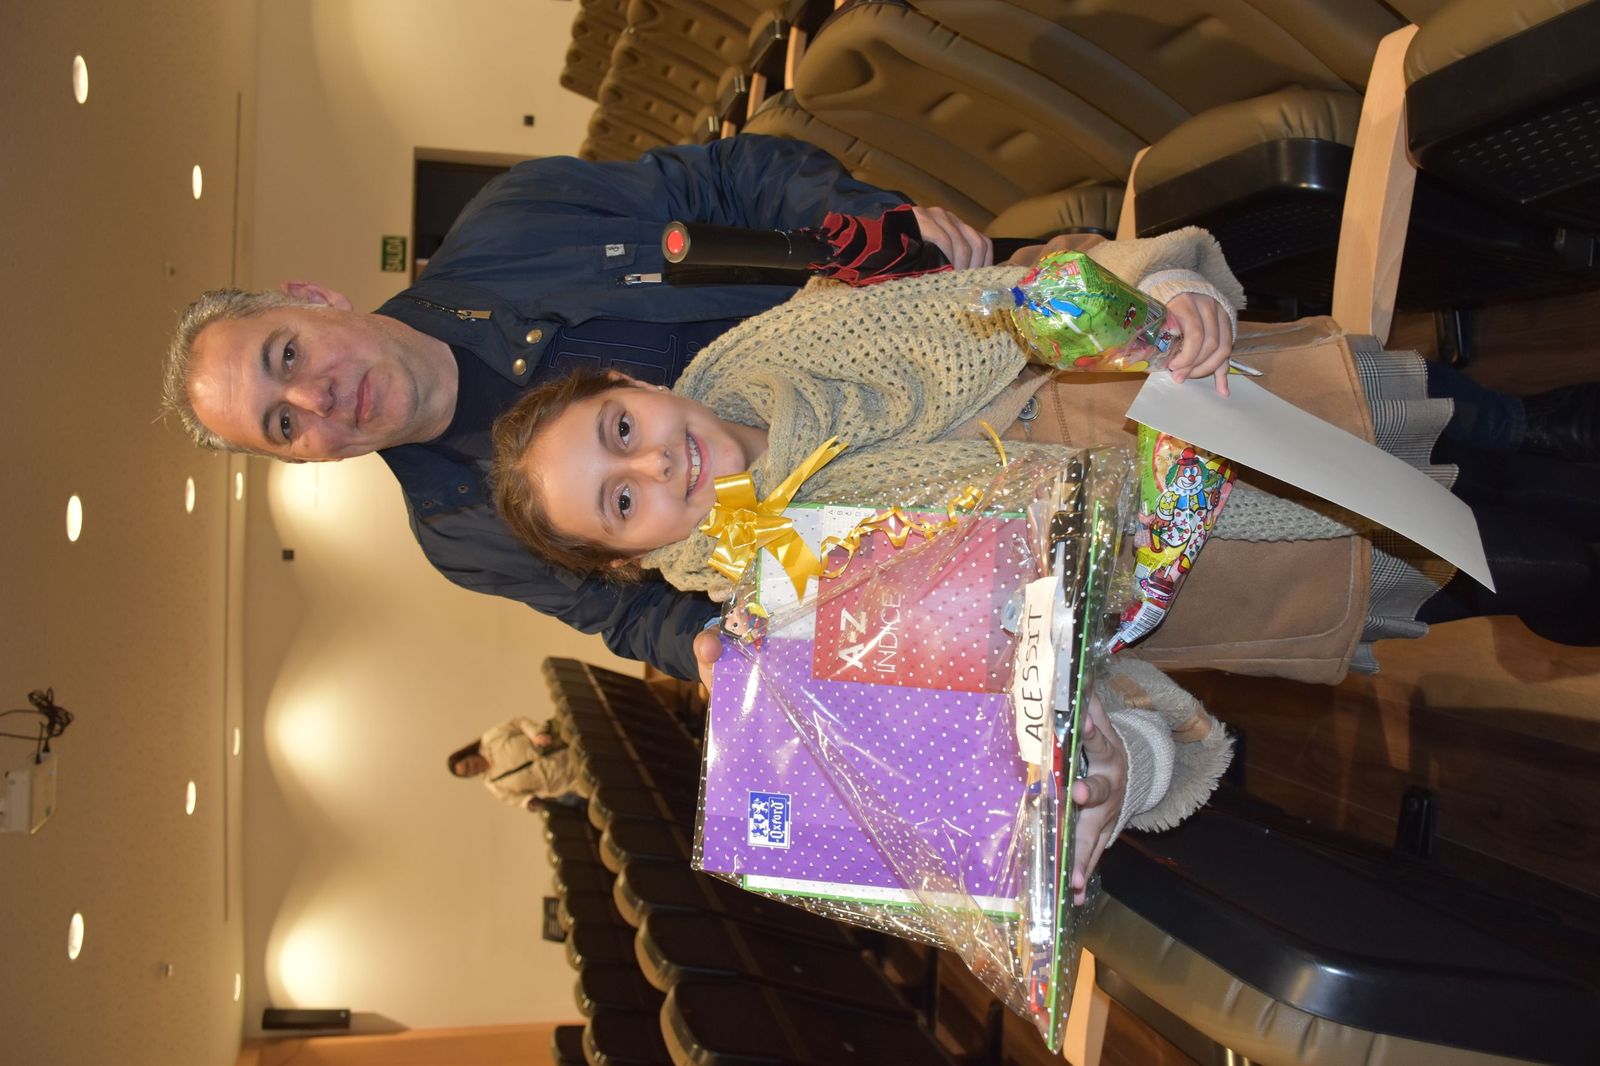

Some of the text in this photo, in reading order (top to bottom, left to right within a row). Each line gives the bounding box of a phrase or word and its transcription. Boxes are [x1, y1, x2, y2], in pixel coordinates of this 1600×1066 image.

[837, 607, 867, 669] A-Z
[872, 592, 901, 673] ÍNDICE
[1022, 604, 1044, 742] ACESSIT
[769, 799, 784, 839] Oxford
